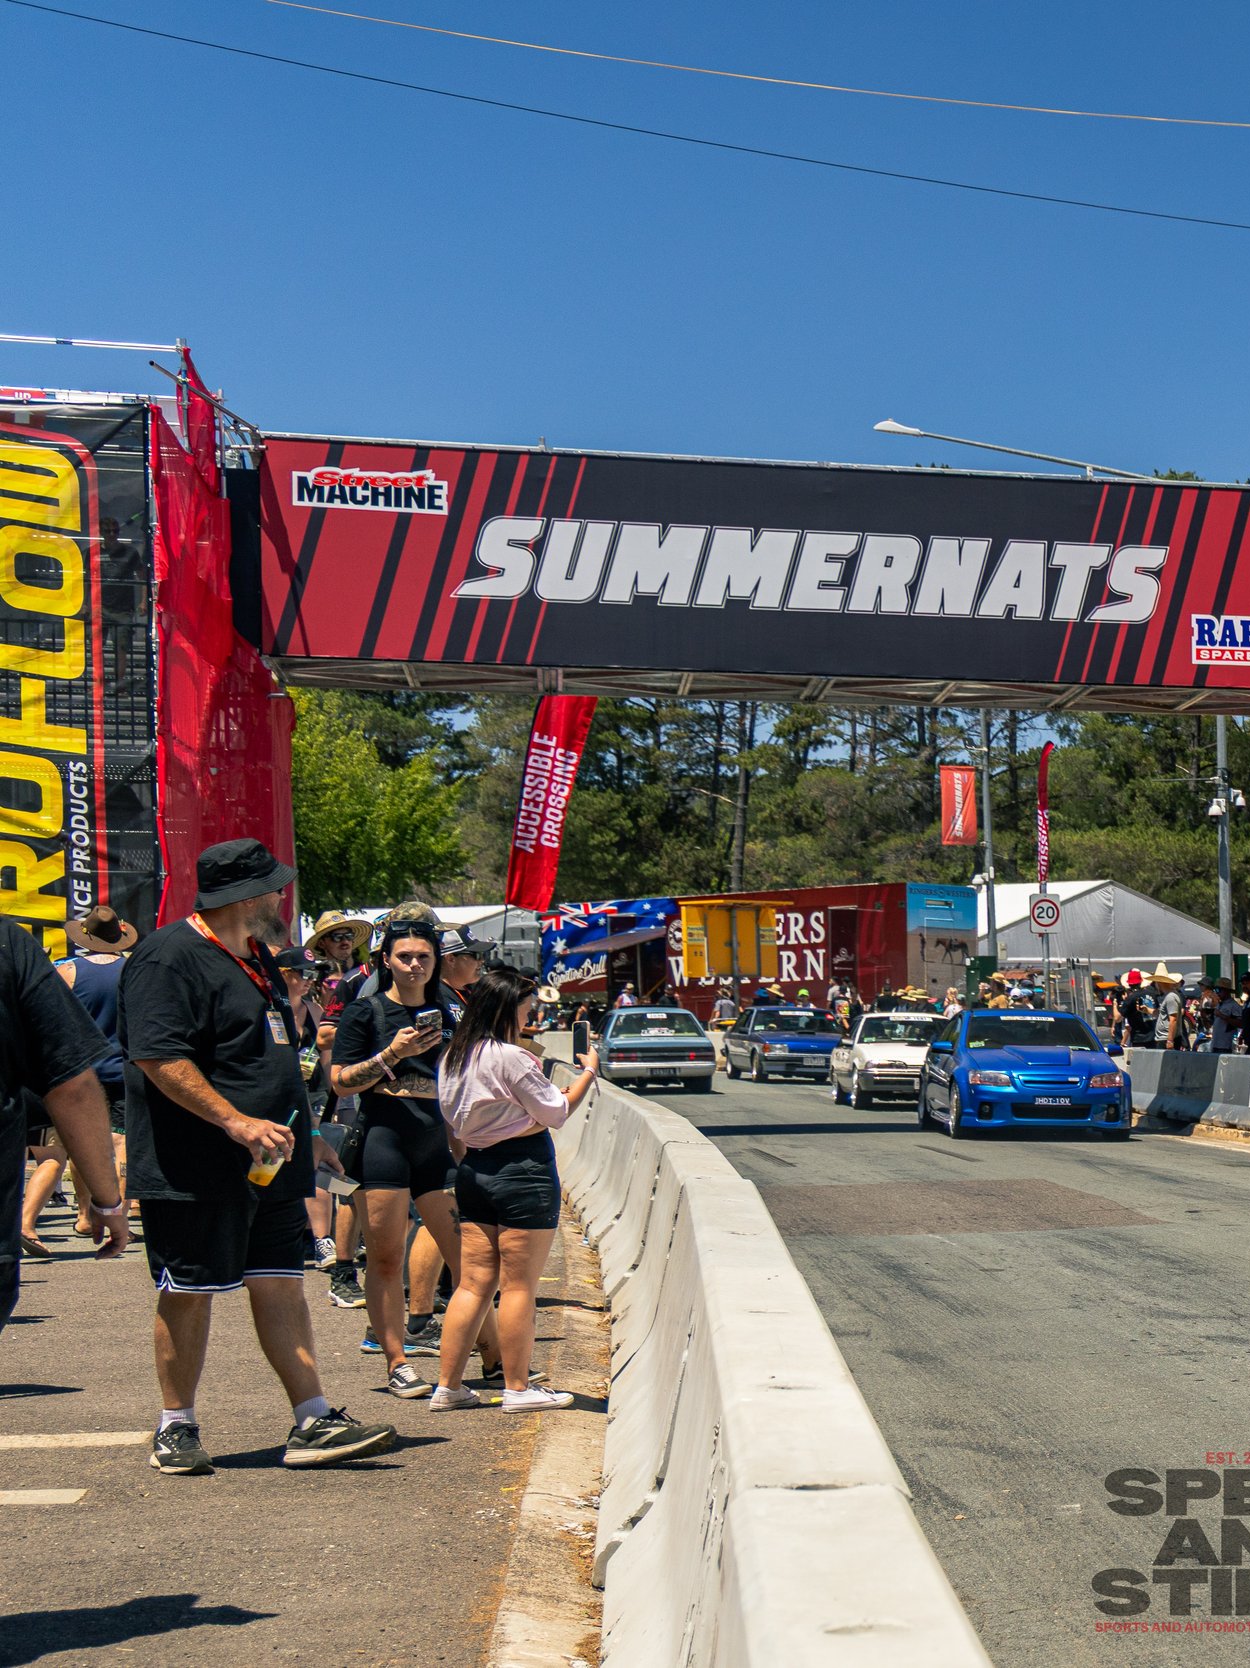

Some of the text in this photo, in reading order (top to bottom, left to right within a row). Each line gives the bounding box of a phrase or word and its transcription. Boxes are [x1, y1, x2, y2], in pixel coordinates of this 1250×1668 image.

[297, 476, 443, 511] MACHINE
[313, 470, 428, 488] Street
[450, 515, 1169, 624] SUMMERNATS
[68, 760, 92, 874] PRODUCTS
[514, 732, 557, 854] ACCESSIBLE
[540, 747, 578, 848] CROSSING
[1036, 906, 1055, 919] 20
